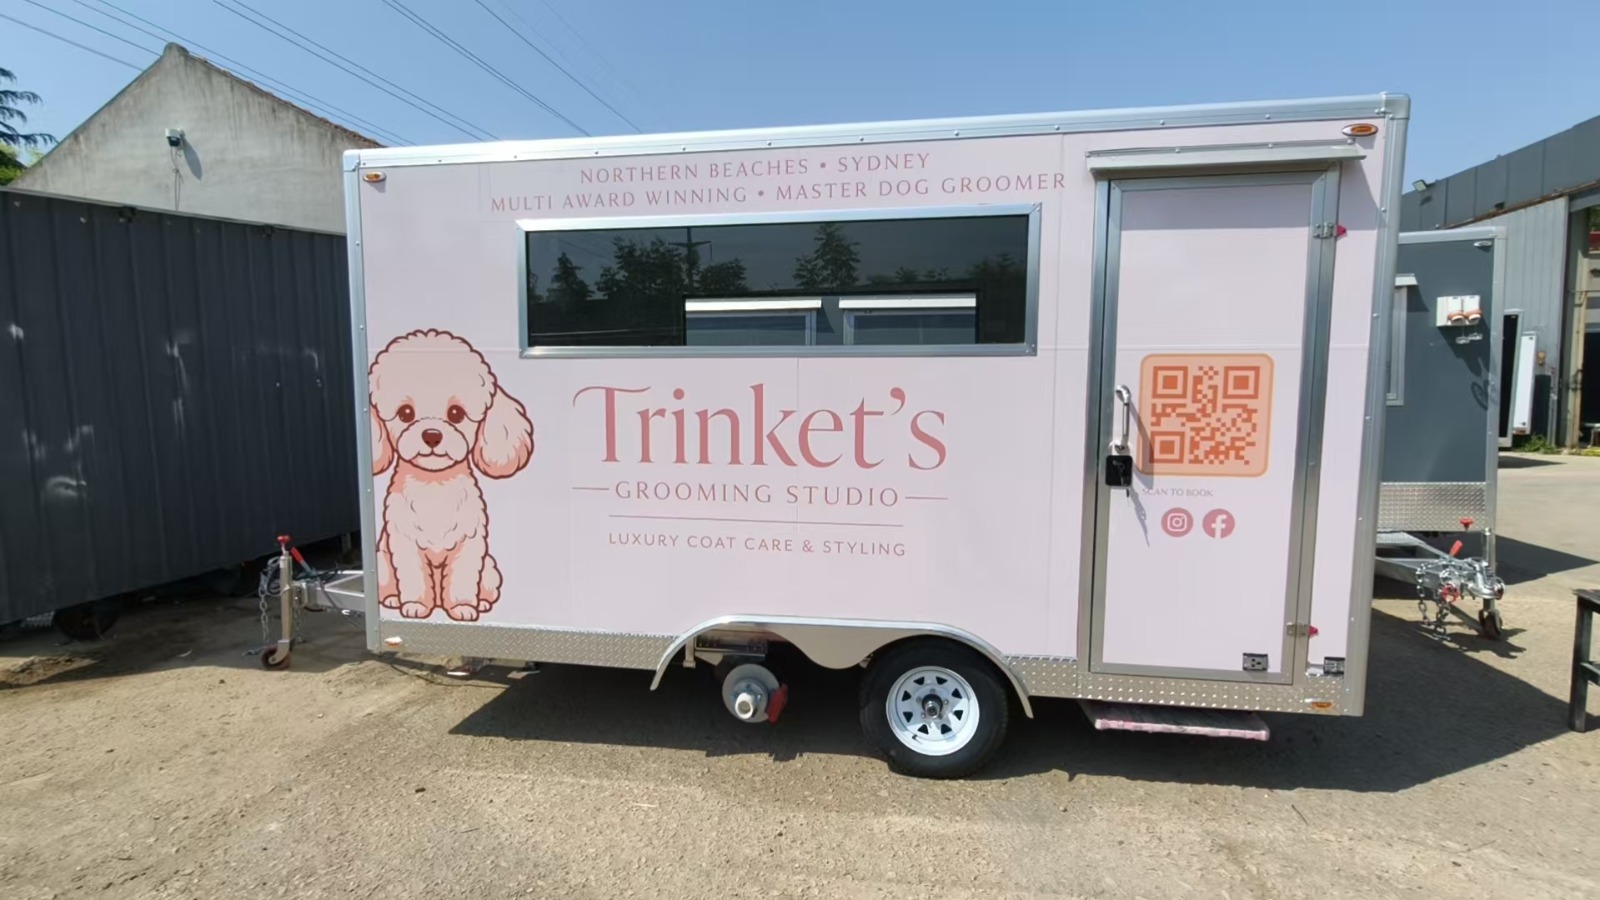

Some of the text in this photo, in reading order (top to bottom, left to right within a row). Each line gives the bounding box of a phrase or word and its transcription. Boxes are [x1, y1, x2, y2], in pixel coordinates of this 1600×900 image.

[580, 152, 931, 184] NORTHERN BEACHES SYDNEY
[490, 172, 1066, 212] MULTI AWARD WINNING MASTER DOG GROOMER
[614, 480, 900, 507] GROOMING STUDIO
[1142, 487, 1214, 498] SCAN TO BOOK
[608, 532, 907, 557] LUXURY COAT CARE & STYLING
